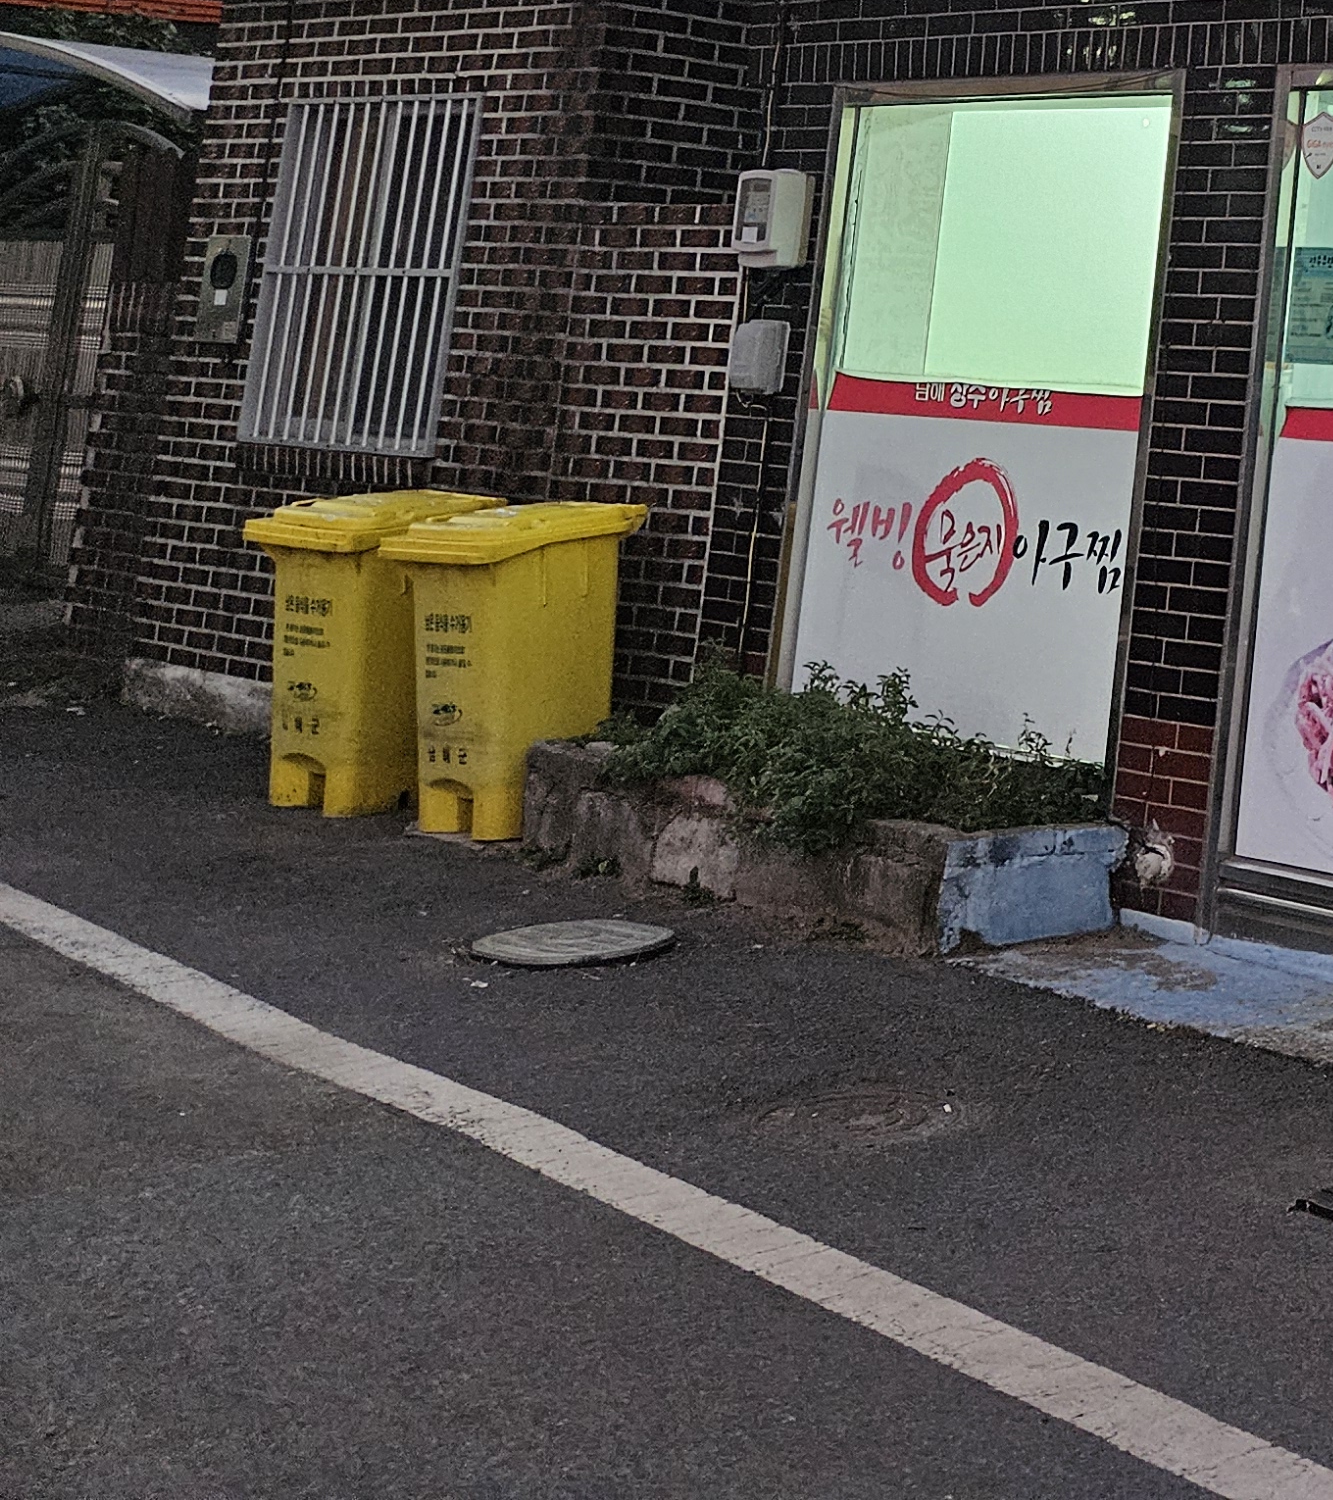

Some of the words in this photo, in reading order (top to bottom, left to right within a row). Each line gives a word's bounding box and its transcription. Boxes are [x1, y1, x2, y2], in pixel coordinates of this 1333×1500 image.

[827, 498, 913, 570] 웰빙
[924, 509, 1002, 592] 묵은지
[1013, 519, 1122, 594] 아구찜
